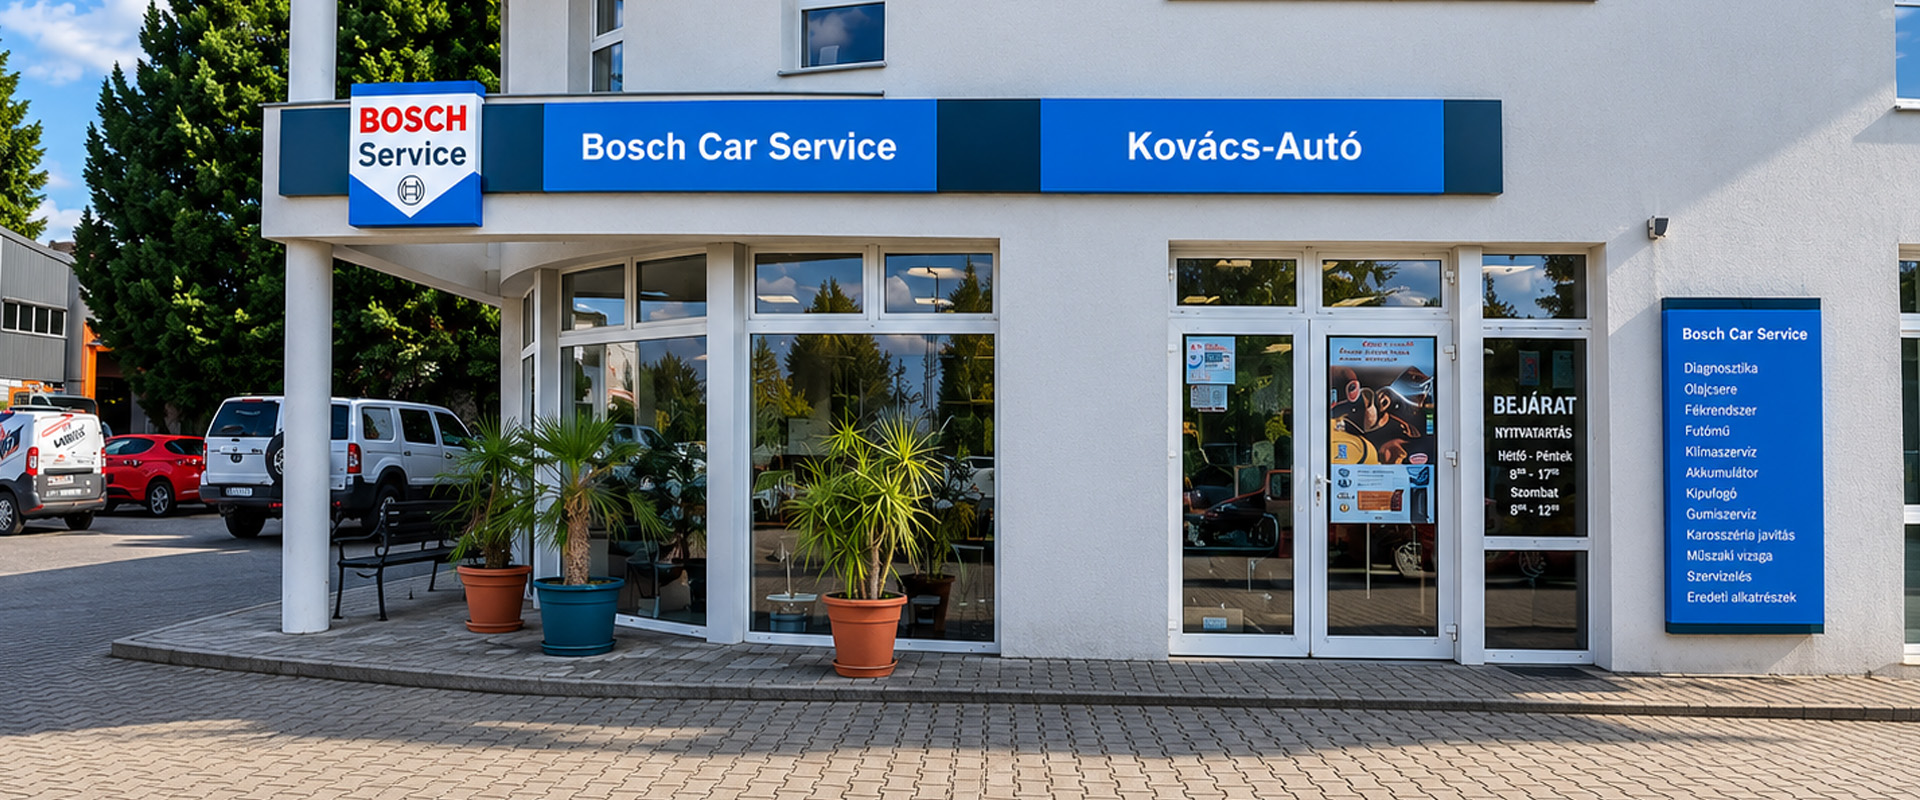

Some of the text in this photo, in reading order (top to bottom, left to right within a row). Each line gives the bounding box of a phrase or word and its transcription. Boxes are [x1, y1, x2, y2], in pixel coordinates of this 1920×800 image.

[360, 105, 467, 133] BOSCH
[582, 132, 897, 161] Bosch Car Service
[1128, 130, 1362, 161] Kovács-Autó
[358, 140, 467, 167] Service
[1682, 326, 1808, 341] Bosch Car Service
[1684, 362, 1759, 376] Diagnosztika
[1684, 383, 1738, 397] Olajcsere
[1493, 391, 1577, 415] BEJÁRAT
[1685, 404, 1757, 416] Fékrendszer
[1536, 450, 1573, 462] Péntek
[1685, 467, 1759, 479] Akkumulátor
[1510, 486, 1559, 498] Szombat
[1686, 488, 1738, 502] Kipufogó
[1686, 508, 1757, 521] Gumiszerviz
[1686, 529, 1756, 541] Karosszéria
[1736, 549, 1773, 564] vizsga
[1687, 570, 1753, 582] Szervizelés
[1687, 591, 1797, 603] Eredeti alkatrészek
